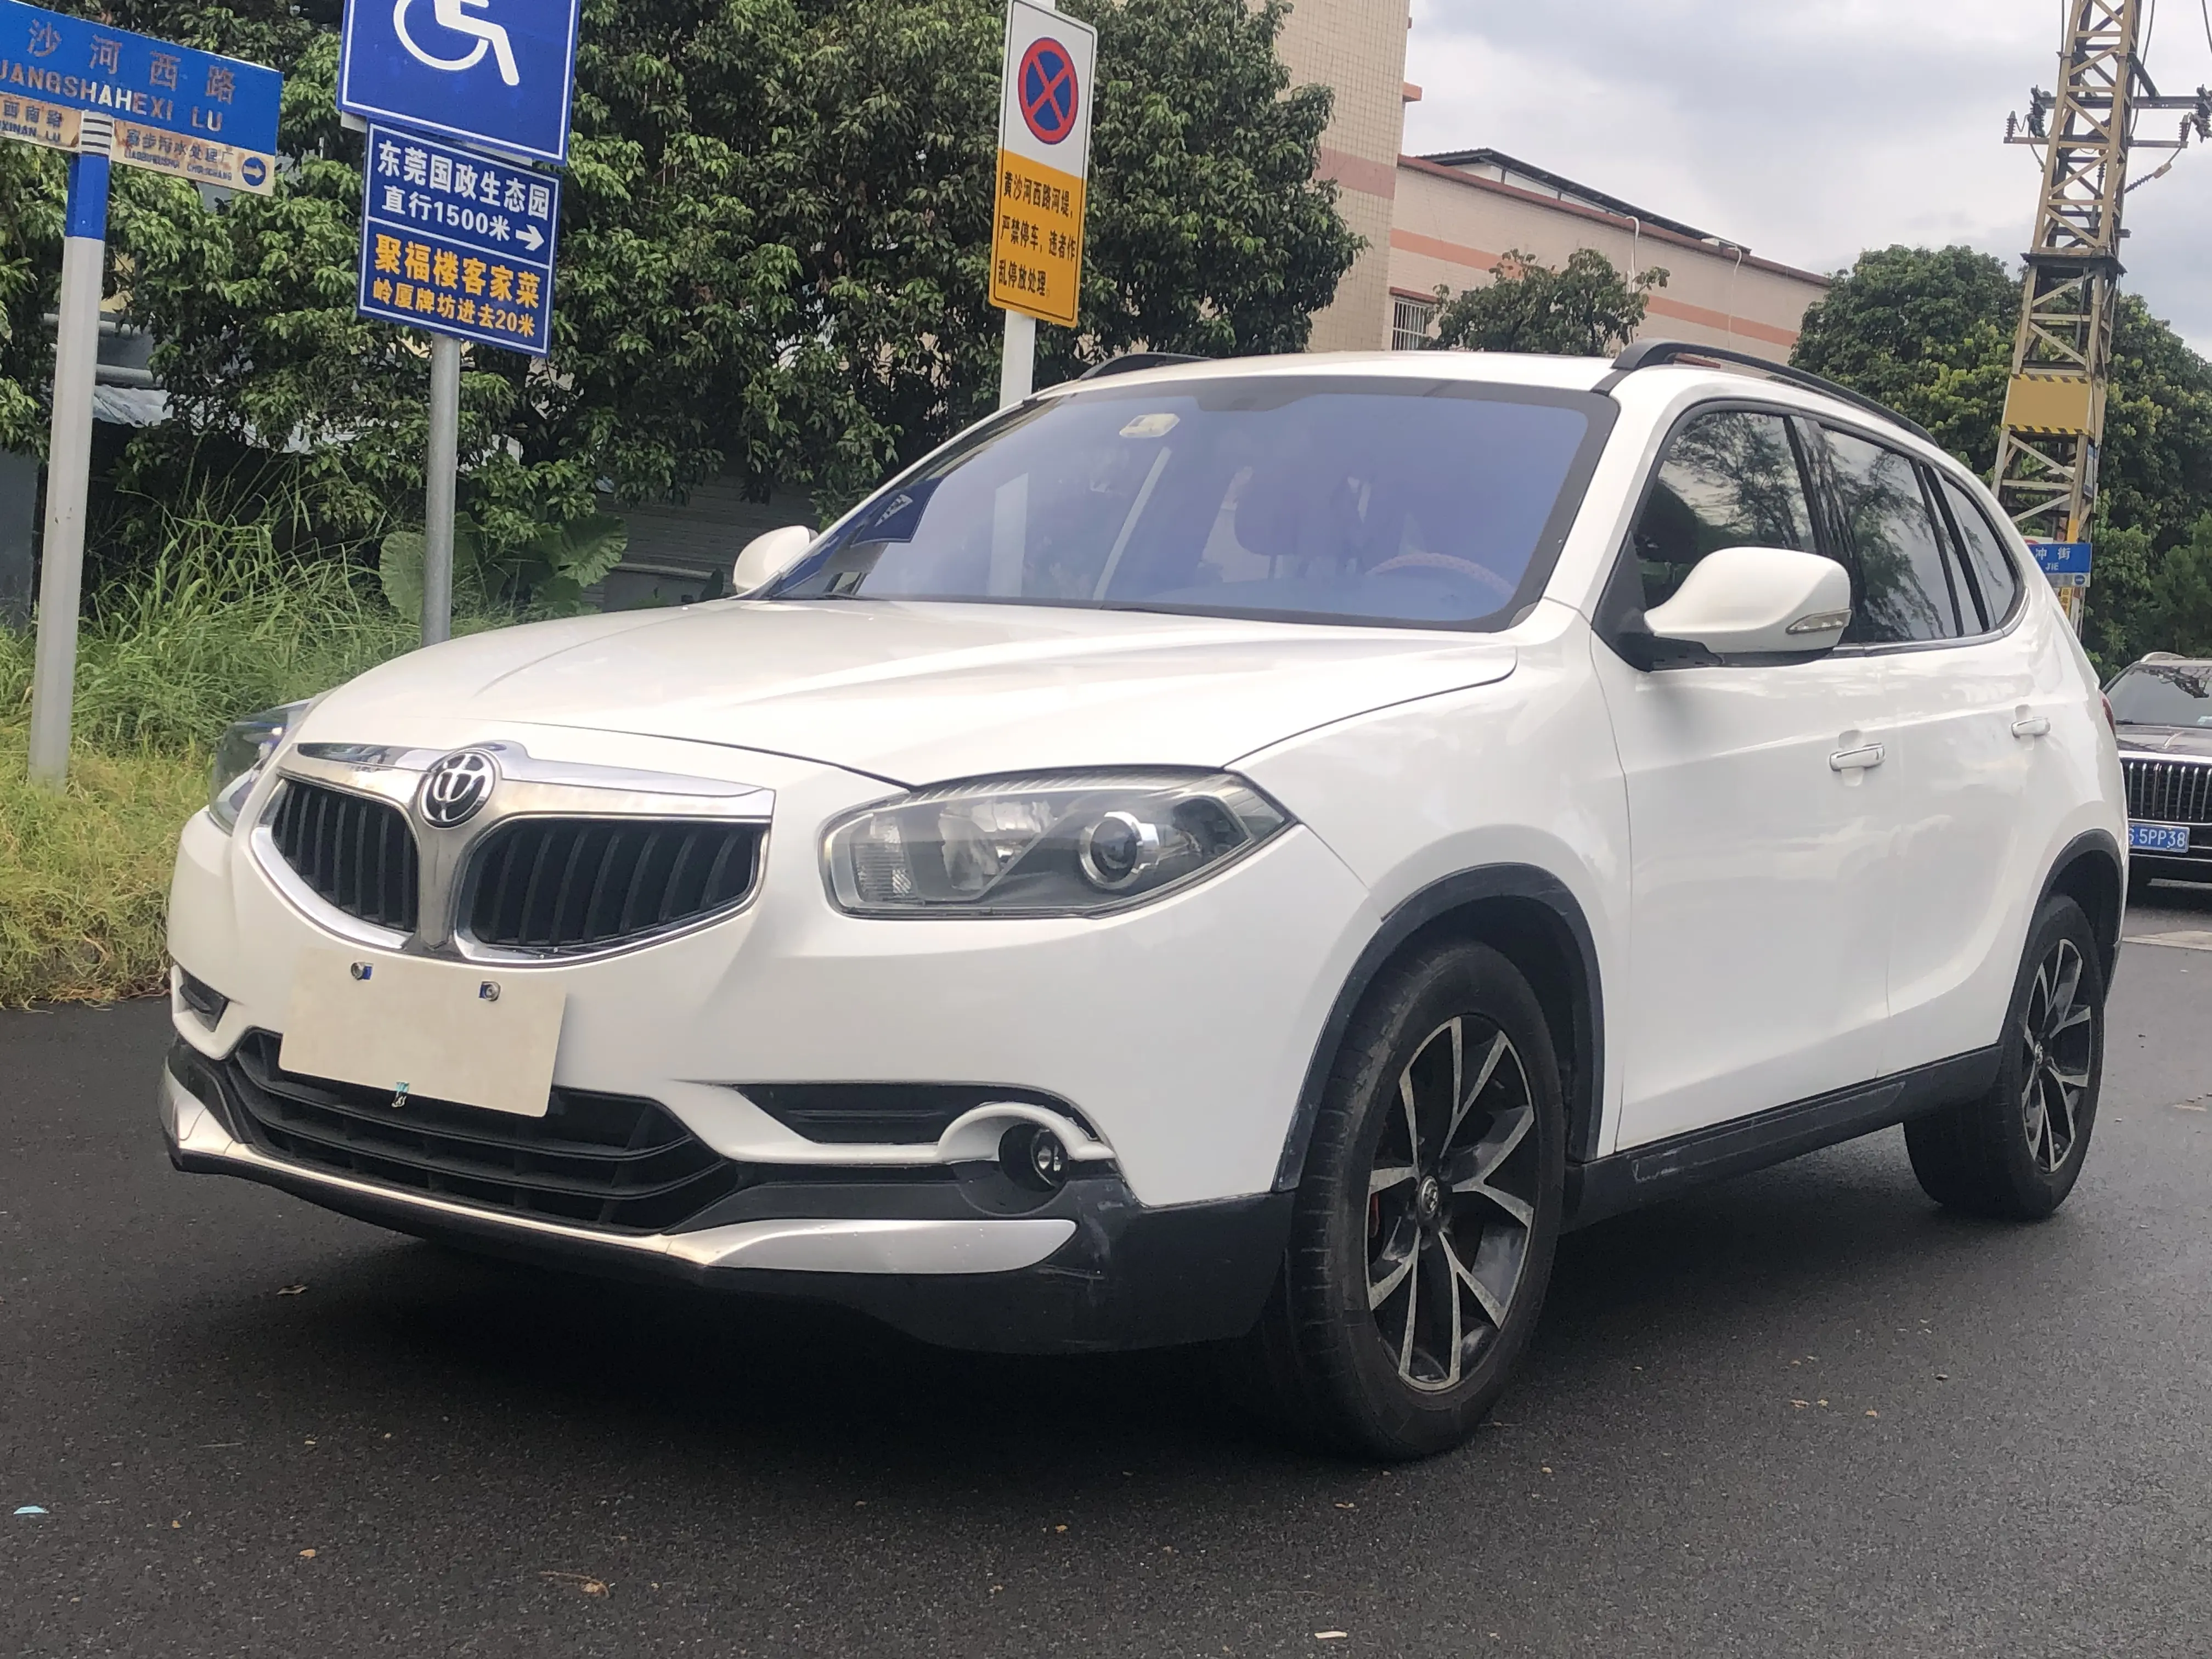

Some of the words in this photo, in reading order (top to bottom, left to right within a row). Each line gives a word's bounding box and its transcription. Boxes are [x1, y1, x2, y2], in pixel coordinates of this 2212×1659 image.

[26, 18, 236, 105] 沙河西路
[46, 130, 61, 143] LU
[192, 106, 223, 132] LU
[377, 140, 550, 221] 东莞国政生态园
[382, 185, 510, 242] 直行1500米
[375, 233, 540, 309] 聚福楼客家菜
[373, 276, 535, 338] 岭厦牌坊进去20米
[2045, 562, 2059, 571] JIE
